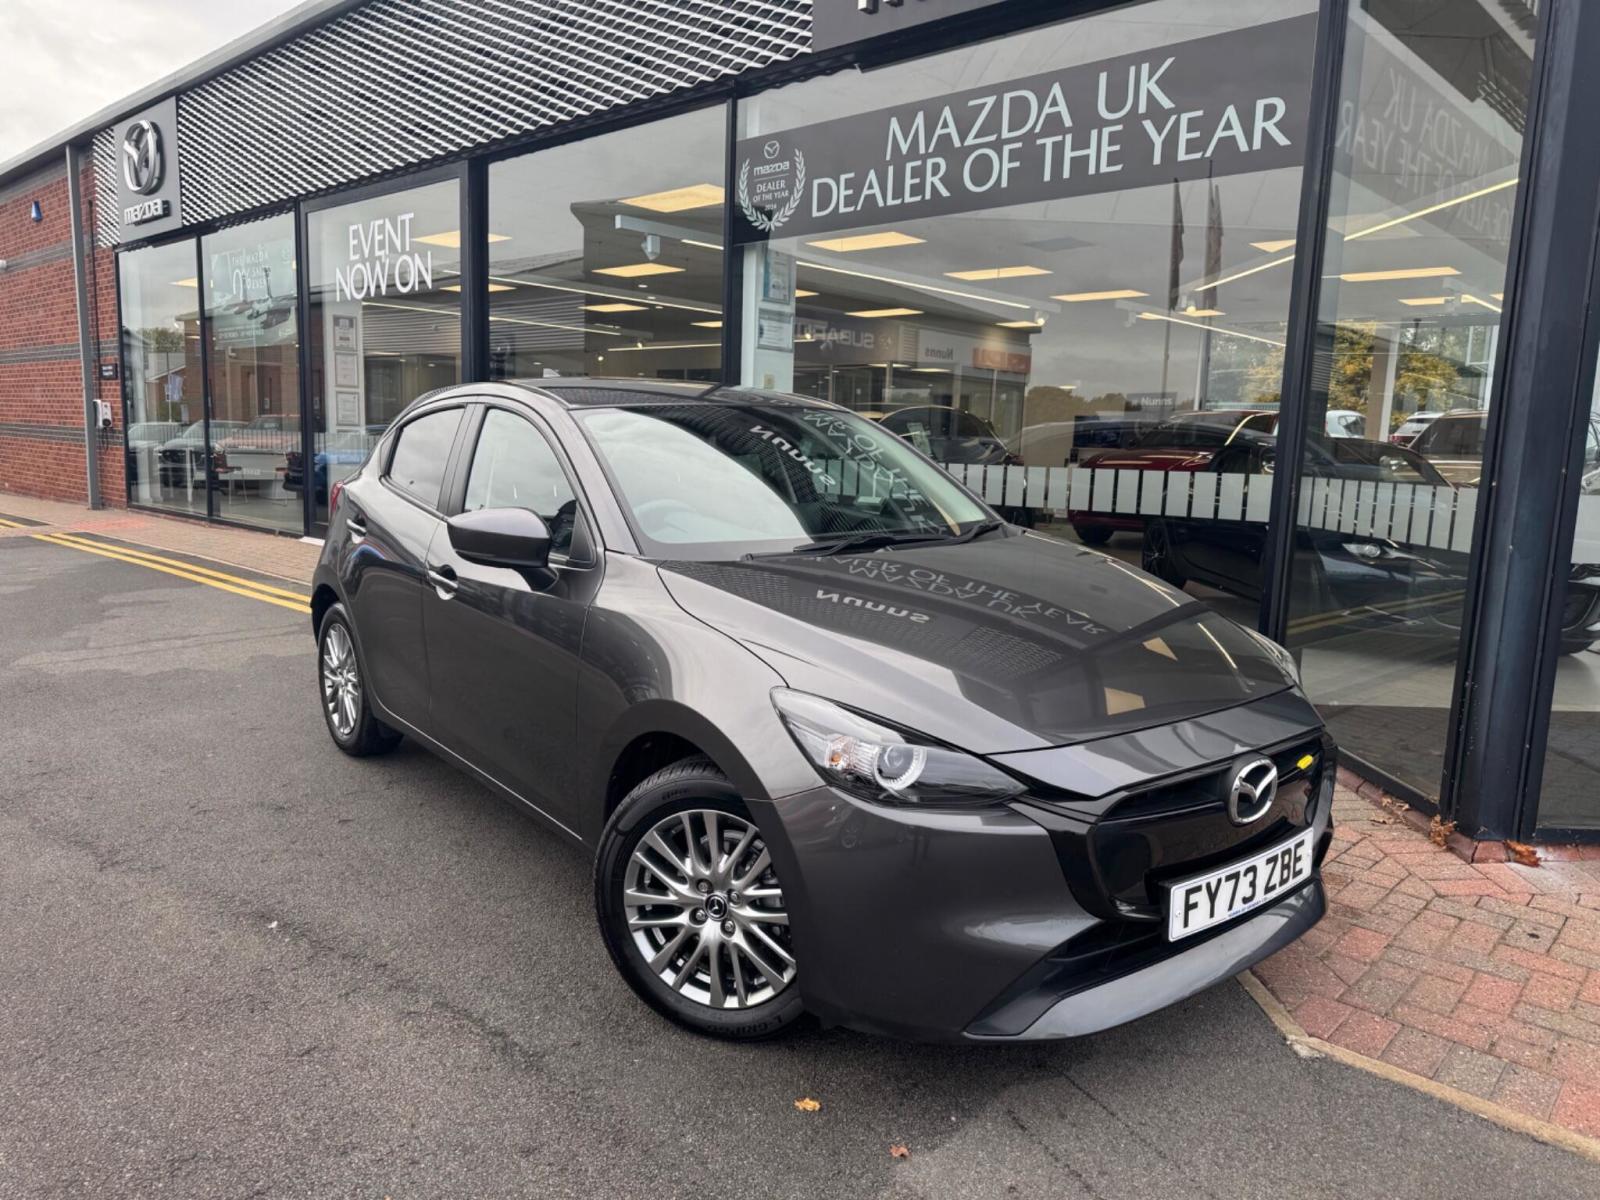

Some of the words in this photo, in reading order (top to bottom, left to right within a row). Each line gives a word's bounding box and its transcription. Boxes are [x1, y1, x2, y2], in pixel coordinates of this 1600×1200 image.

[886, 81, 1073, 161] MAZDA
[1097, 56, 1176, 121] UK
[753, 160, 790, 176] mazda
[811, 156, 951, 218] DEALER
[962, 141, 1023, 193] OF
[1036, 124, 1124, 183] THE
[1142, 96, 1292, 166] YEAR
[124, 198, 164, 225] mazda
[756, 179, 786, 193] DEALER
[349, 212, 415, 261] EVENT
[336, 257, 390, 303] NOW
[395, 250, 432, 293] ON
[1183, 864, 1258, 929] FY73
[1263, 839, 1305, 896] ZBE
